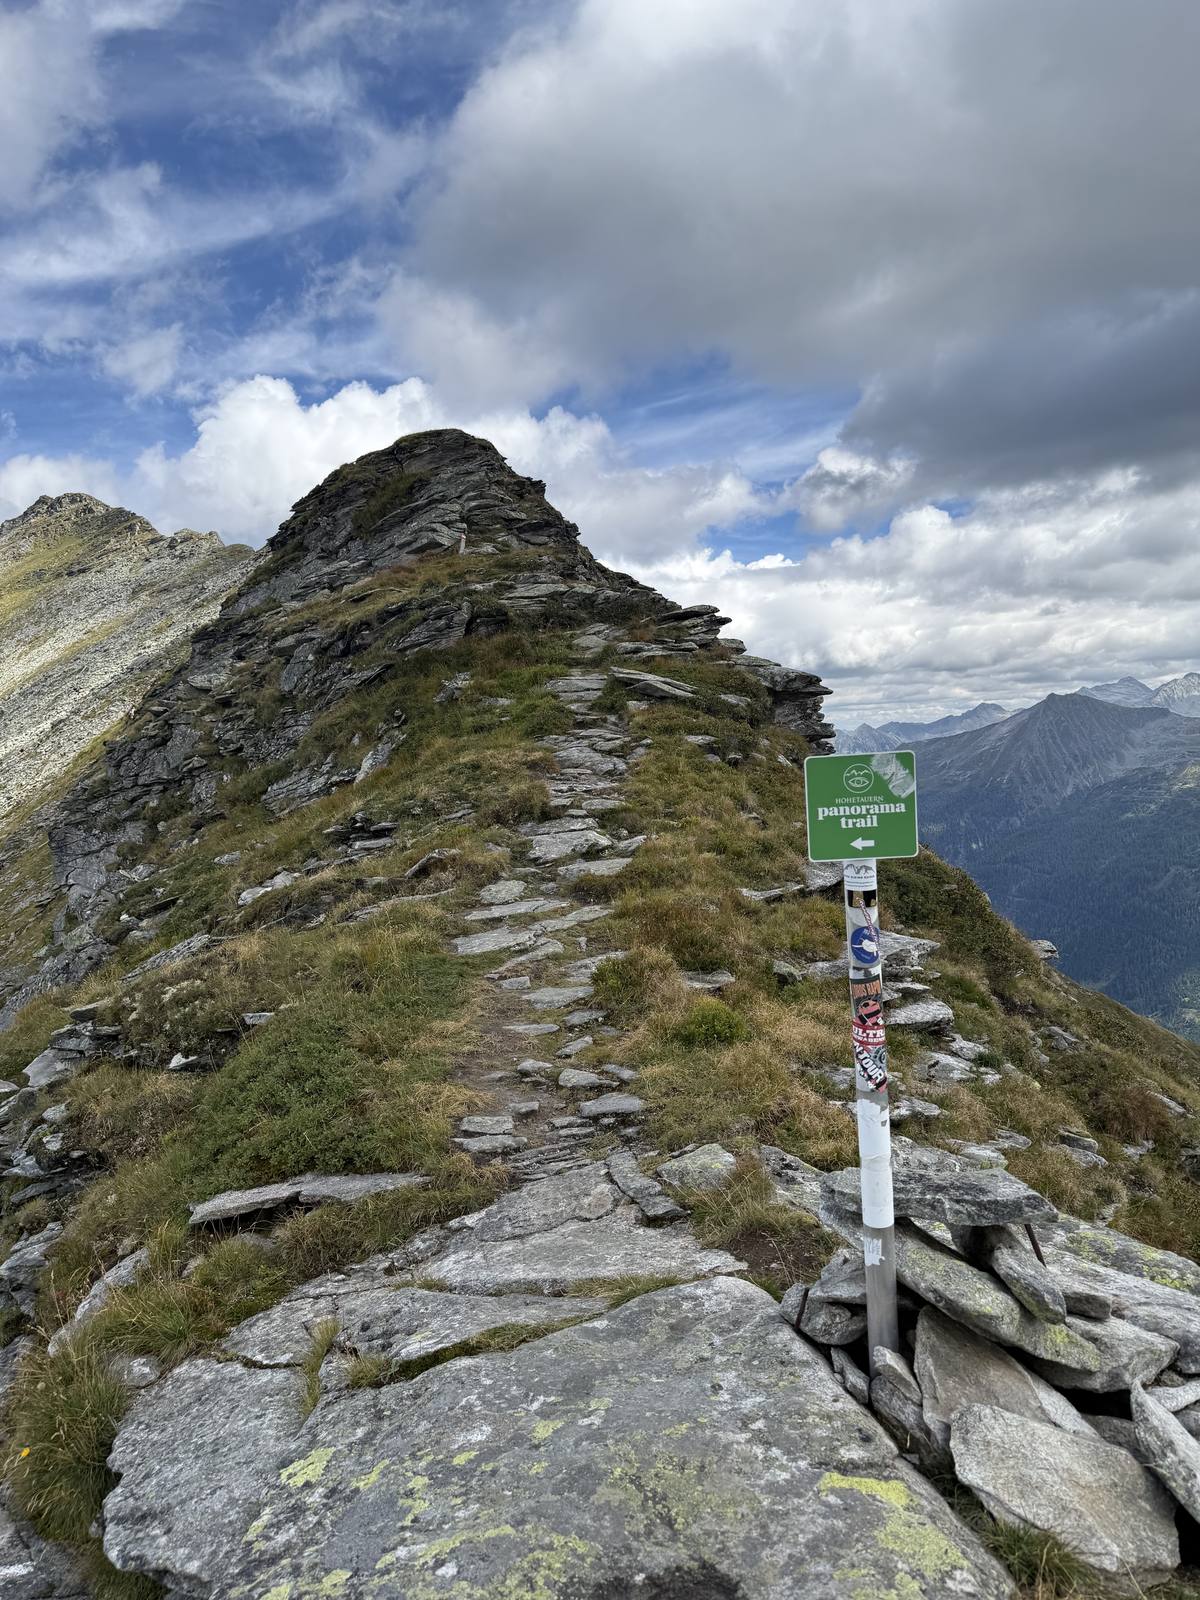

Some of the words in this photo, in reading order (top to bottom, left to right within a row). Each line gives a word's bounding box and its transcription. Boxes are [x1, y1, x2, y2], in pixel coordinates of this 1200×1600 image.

[817, 803, 906, 820] panorama
[840, 815, 878, 829] trail
[859, 1050, 884, 1082] TOUR
